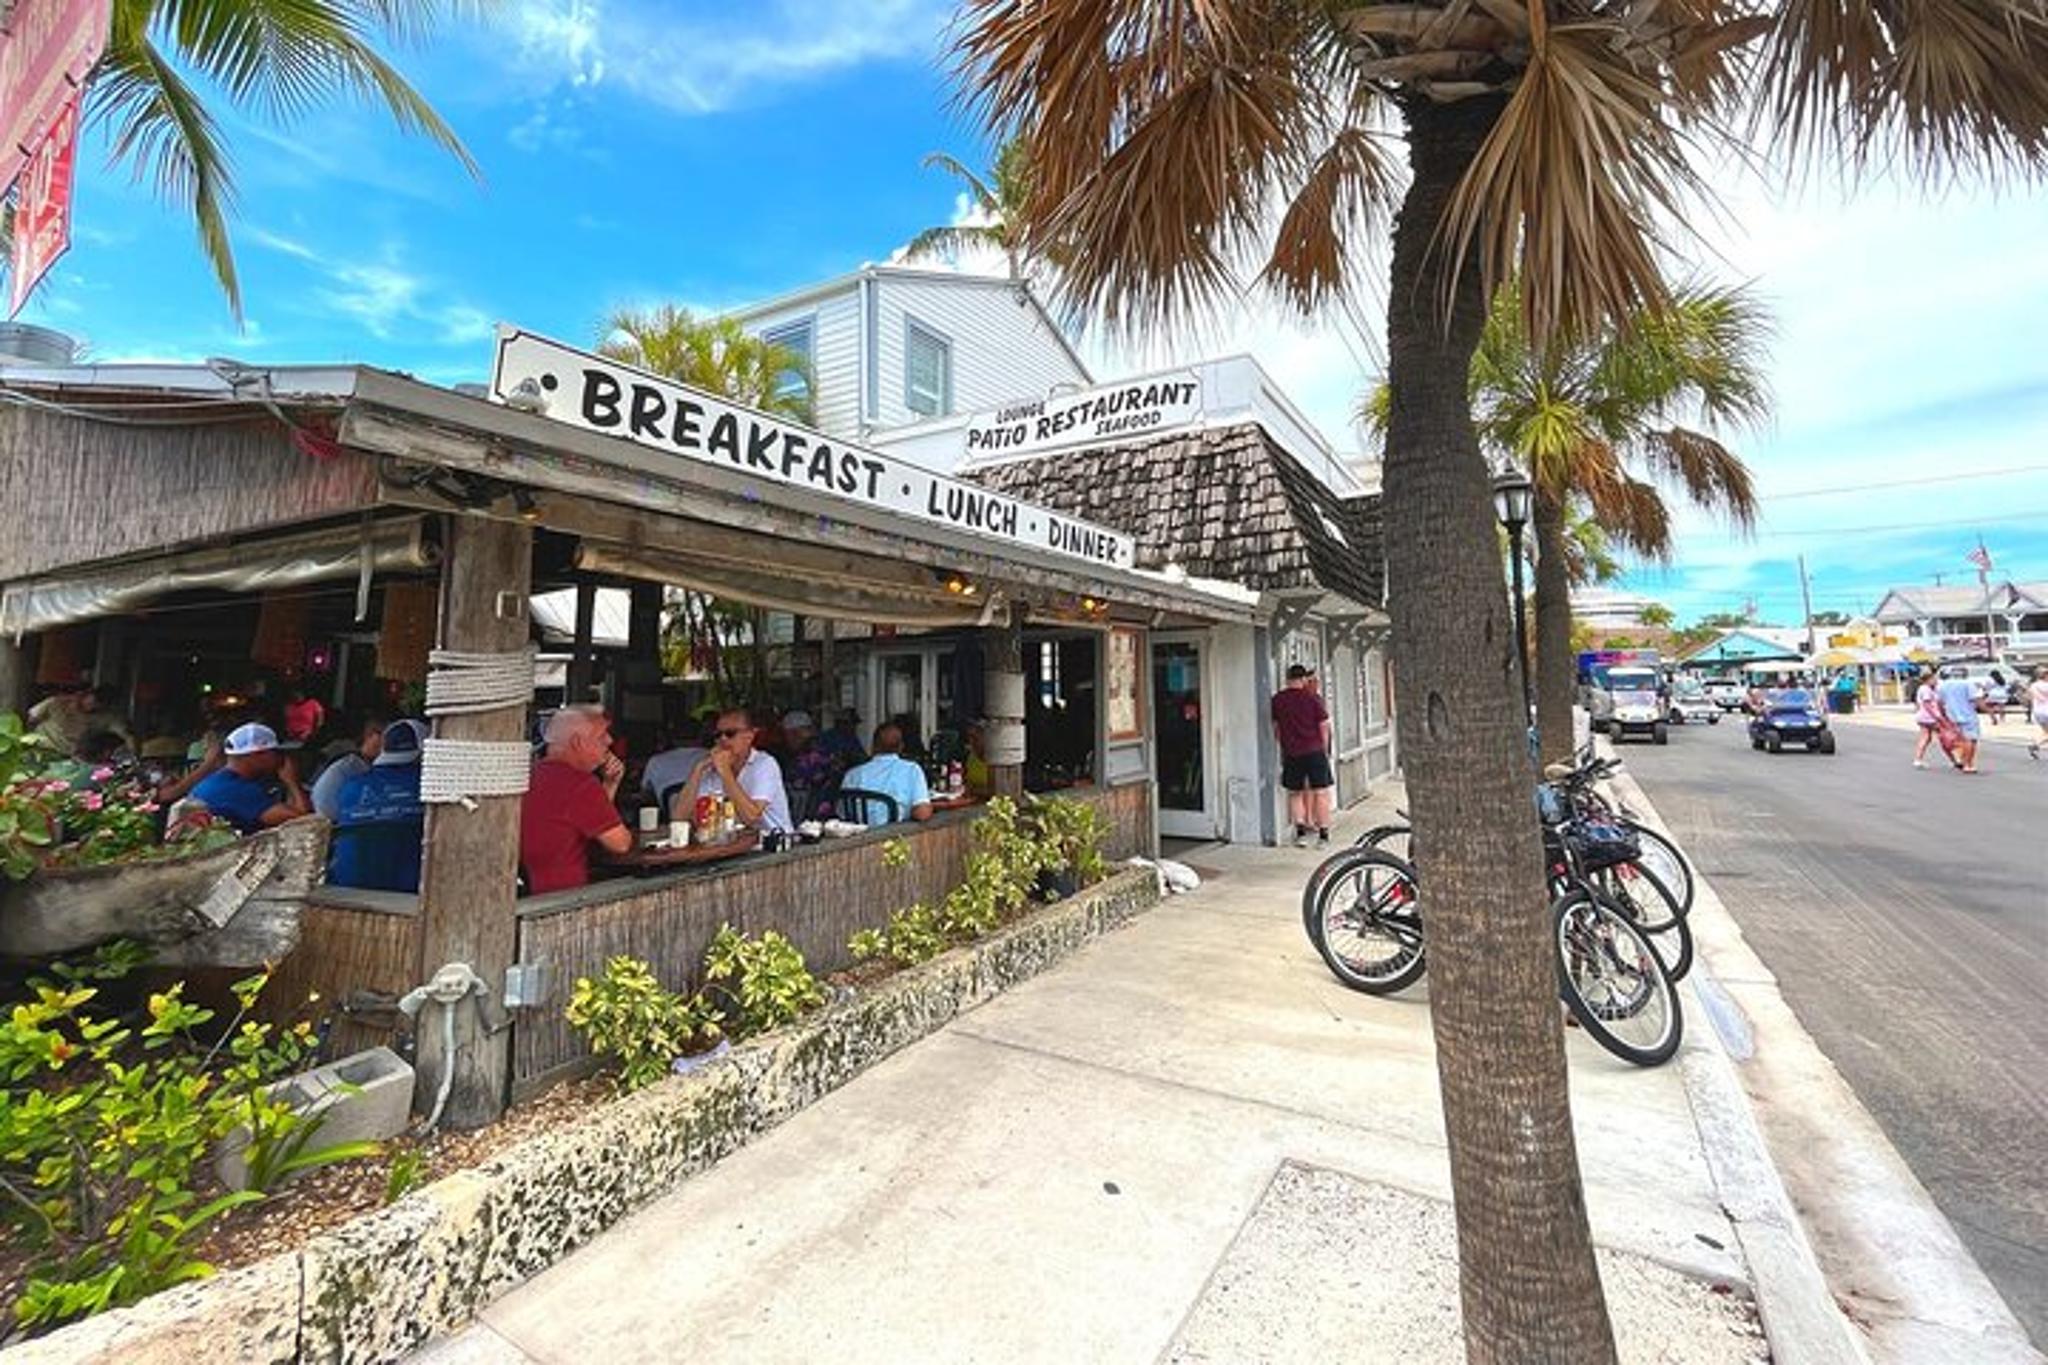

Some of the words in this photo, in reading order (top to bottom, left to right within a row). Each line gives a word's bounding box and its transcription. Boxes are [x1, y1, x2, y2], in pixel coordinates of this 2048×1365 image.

[996, 401, 1046, 424] LOUNGE
[1036, 383, 1197, 440] RESTAURANT
[1095, 411, 1161, 436] SEAFOOD
[582, 369, 885, 498] BREAKFAST
[928, 480, 1017, 536] LUNCH
[1048, 518, 1118, 563] DINNER
